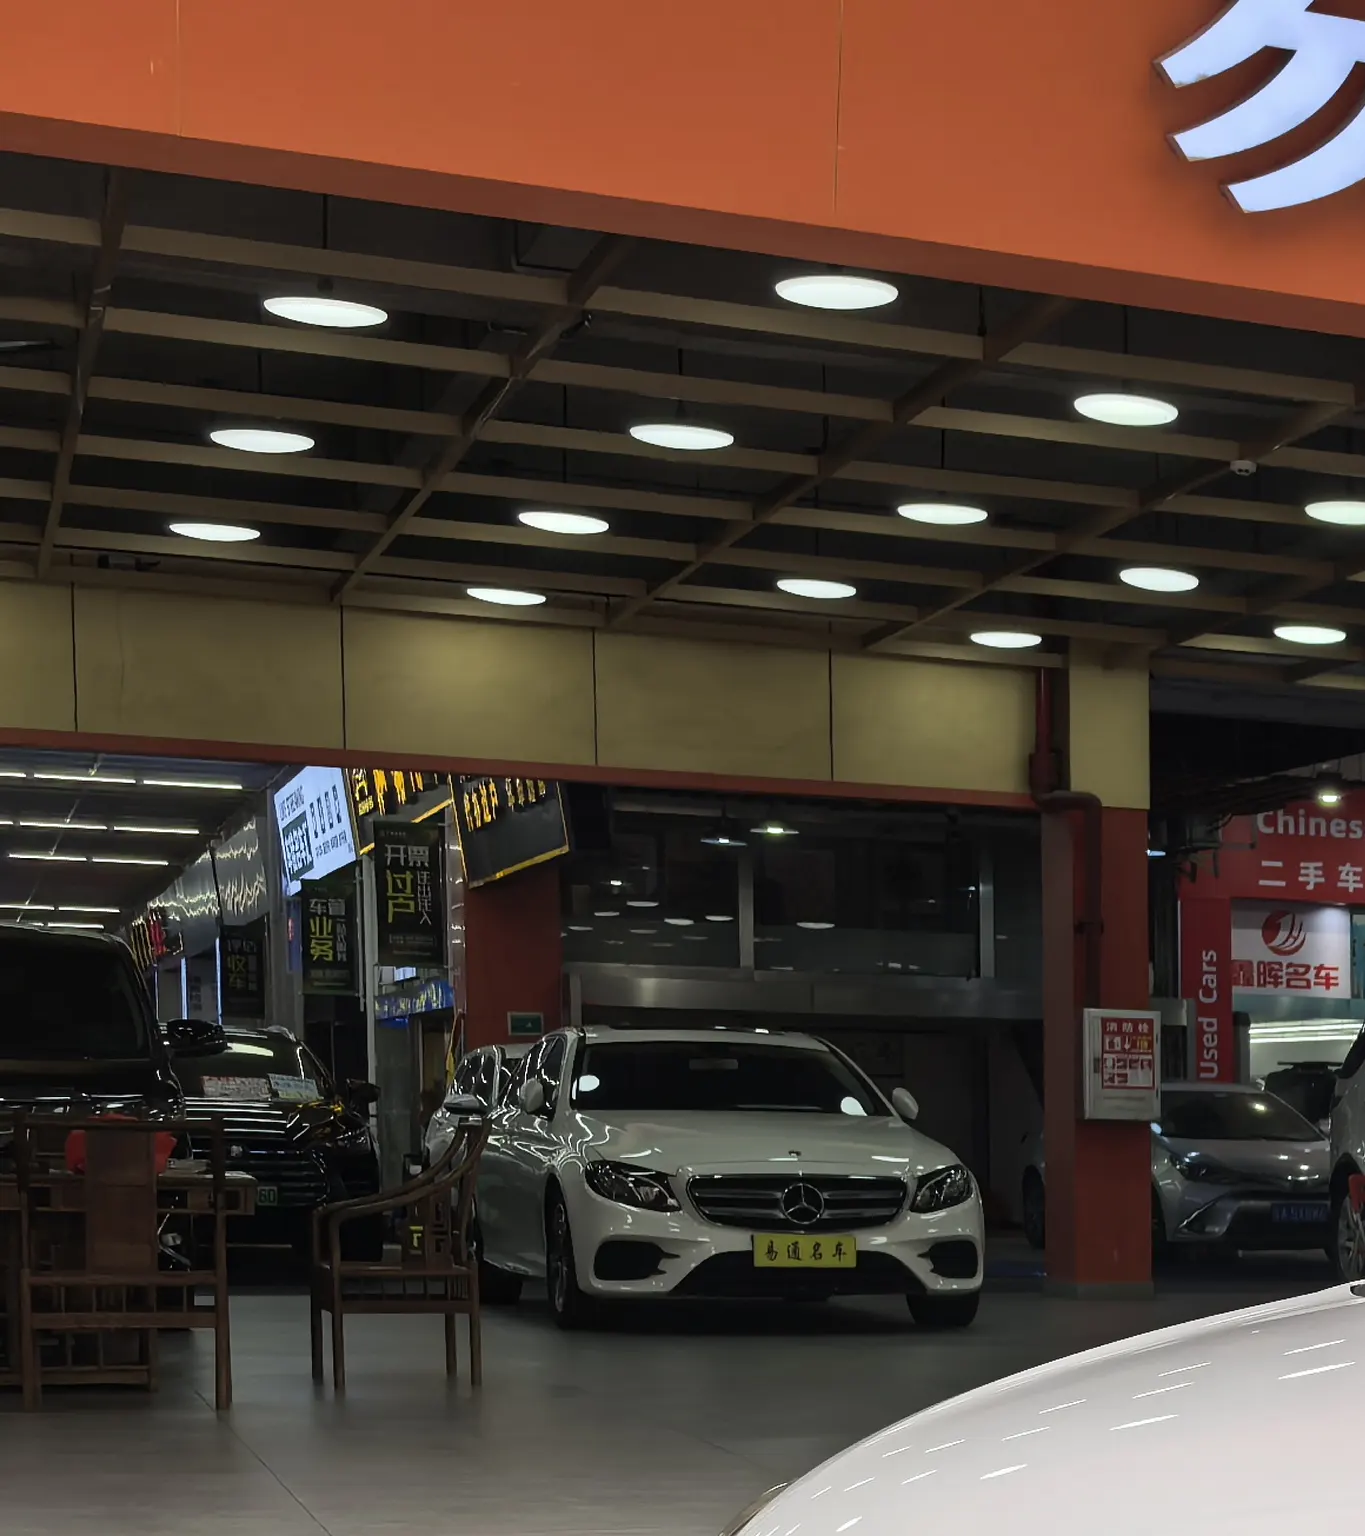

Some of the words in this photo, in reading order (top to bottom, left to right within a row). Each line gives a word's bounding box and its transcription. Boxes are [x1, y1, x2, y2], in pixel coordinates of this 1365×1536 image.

[385, 844, 430, 867] 开票
[386, 869, 415, 924] 过户
[310, 916, 333, 961] 业务
[1198, 950, 1217, 1003] Cars
[1198, 1017, 1218, 1078] Used
[765, 1239, 847, 1262] 易通名车
